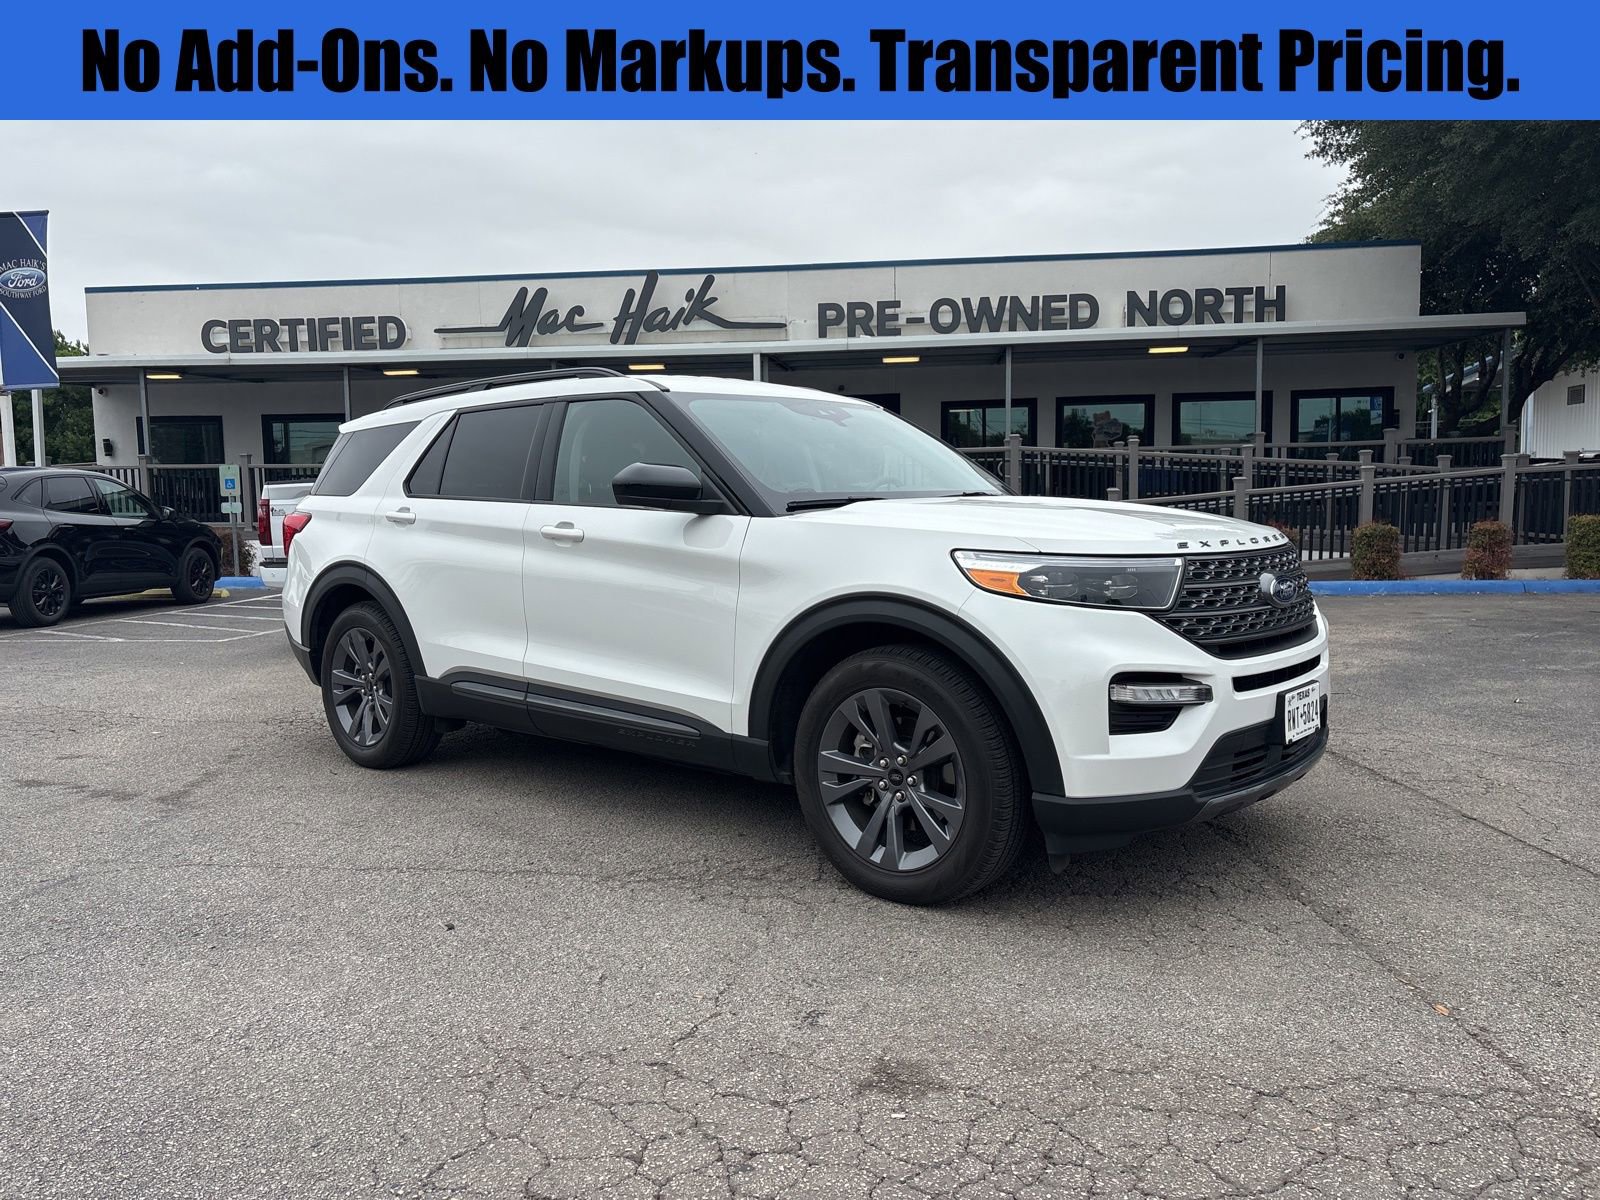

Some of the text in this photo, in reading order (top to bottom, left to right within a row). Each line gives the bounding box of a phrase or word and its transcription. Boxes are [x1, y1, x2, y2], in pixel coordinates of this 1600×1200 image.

[20, 258, 46, 270] HAIK'S
[8, 272, 38, 288] Ford
[200, 271, 1287, 354] CERTIFIED Mac Haik PRE-OWNED NORTH
[1176, 532, 1286, 549] EXPLORER
